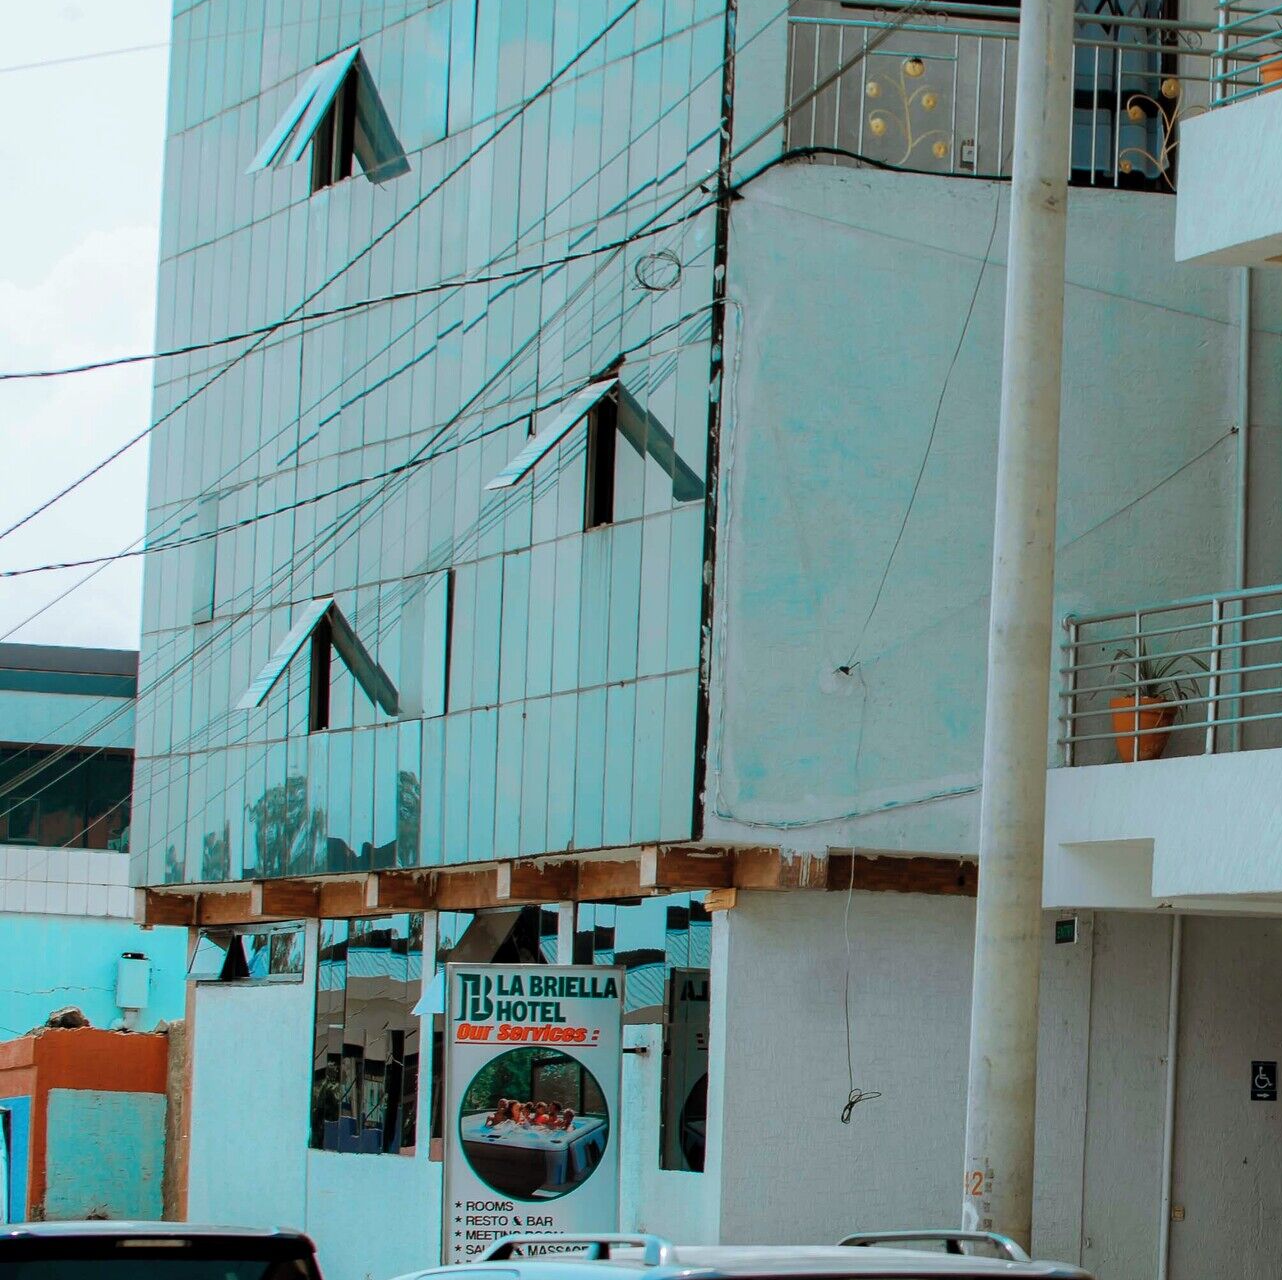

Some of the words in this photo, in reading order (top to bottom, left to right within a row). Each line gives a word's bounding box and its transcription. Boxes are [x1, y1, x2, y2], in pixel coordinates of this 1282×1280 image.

[497, 974, 524, 997] LA
[529, 975, 618, 999] BRIELLA
[496, 1000, 567, 1023] HOTEL
[456, 1023, 494, 1041] Our
[496, 1024, 588, 1043] Services
[466, 1201, 514, 1211] ROOMS
[465, 1216, 509, 1227] RESTO
[526, 1216, 554, 1227] BAR
